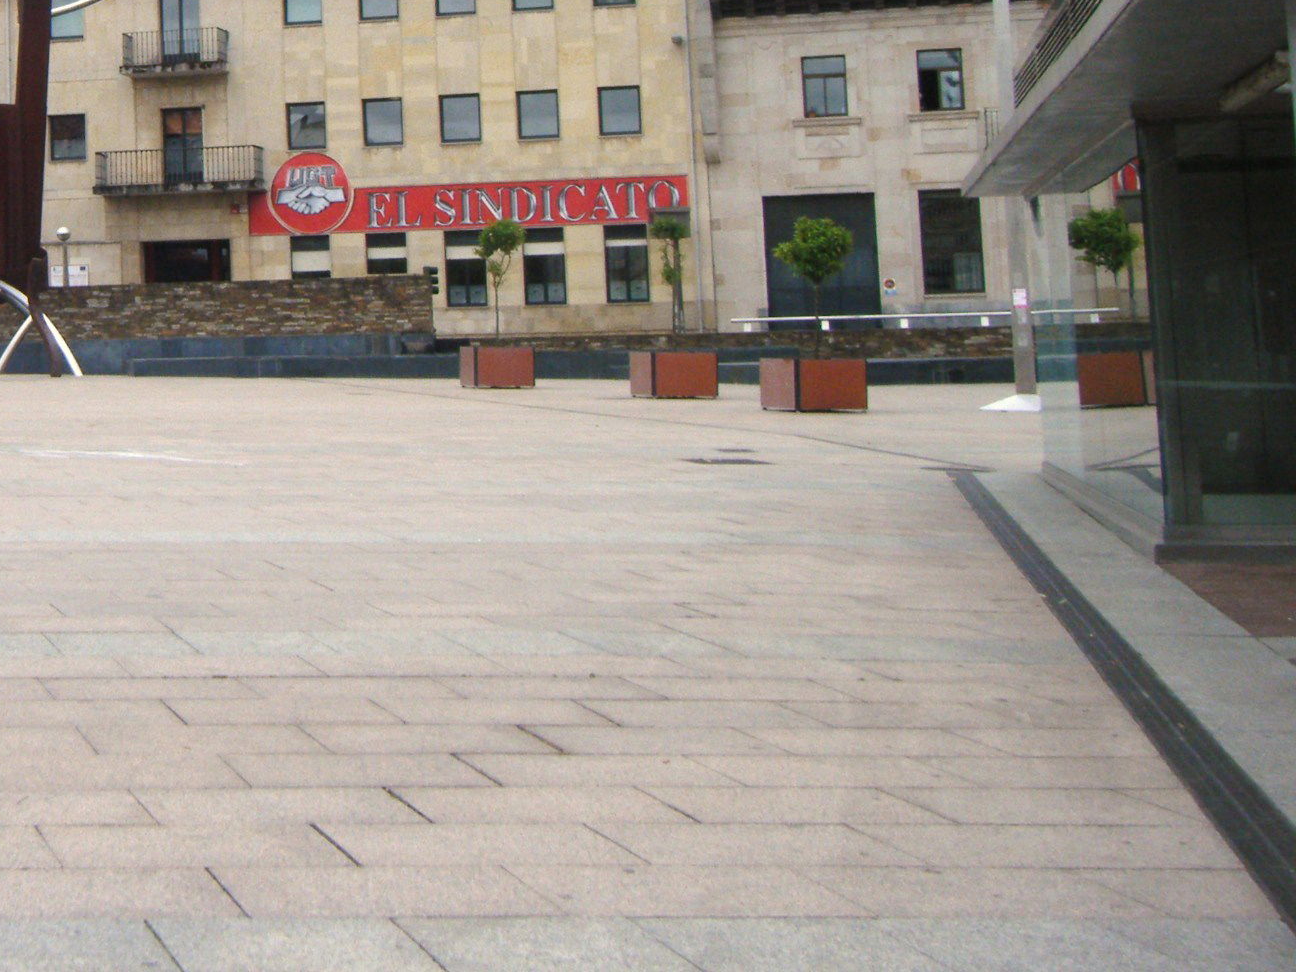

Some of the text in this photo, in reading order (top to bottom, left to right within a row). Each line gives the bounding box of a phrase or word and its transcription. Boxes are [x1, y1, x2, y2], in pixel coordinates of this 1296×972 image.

[287, 165, 336, 188] UGT
[368, 180, 680, 228] EL SINDICATO
